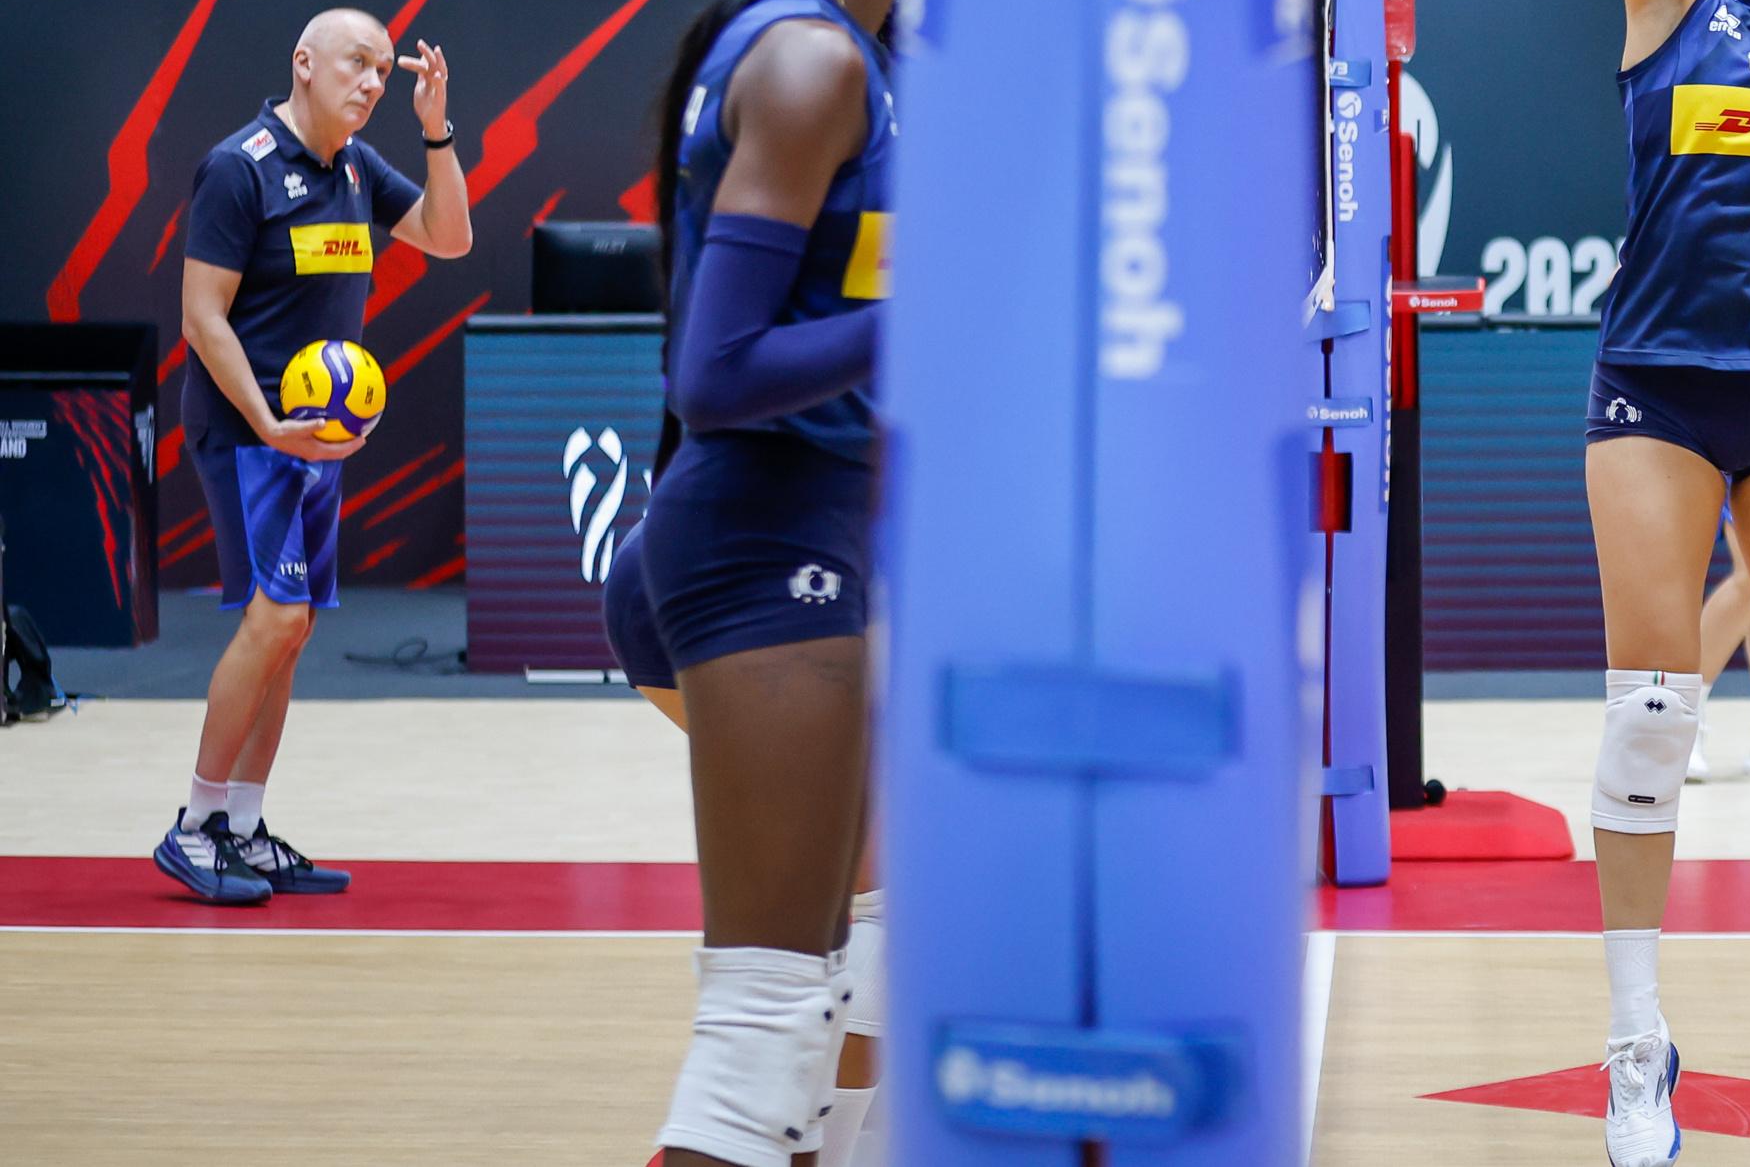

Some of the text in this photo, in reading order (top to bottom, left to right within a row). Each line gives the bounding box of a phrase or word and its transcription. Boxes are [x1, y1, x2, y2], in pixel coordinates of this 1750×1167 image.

[1338, 120, 1358, 222] Senoh
[322, 240, 362, 256] DHL
[1480, 236, 1626, 316] 202
[1319, 407, 1368, 421] Senoh
[0, 438, 27, 459] AND
